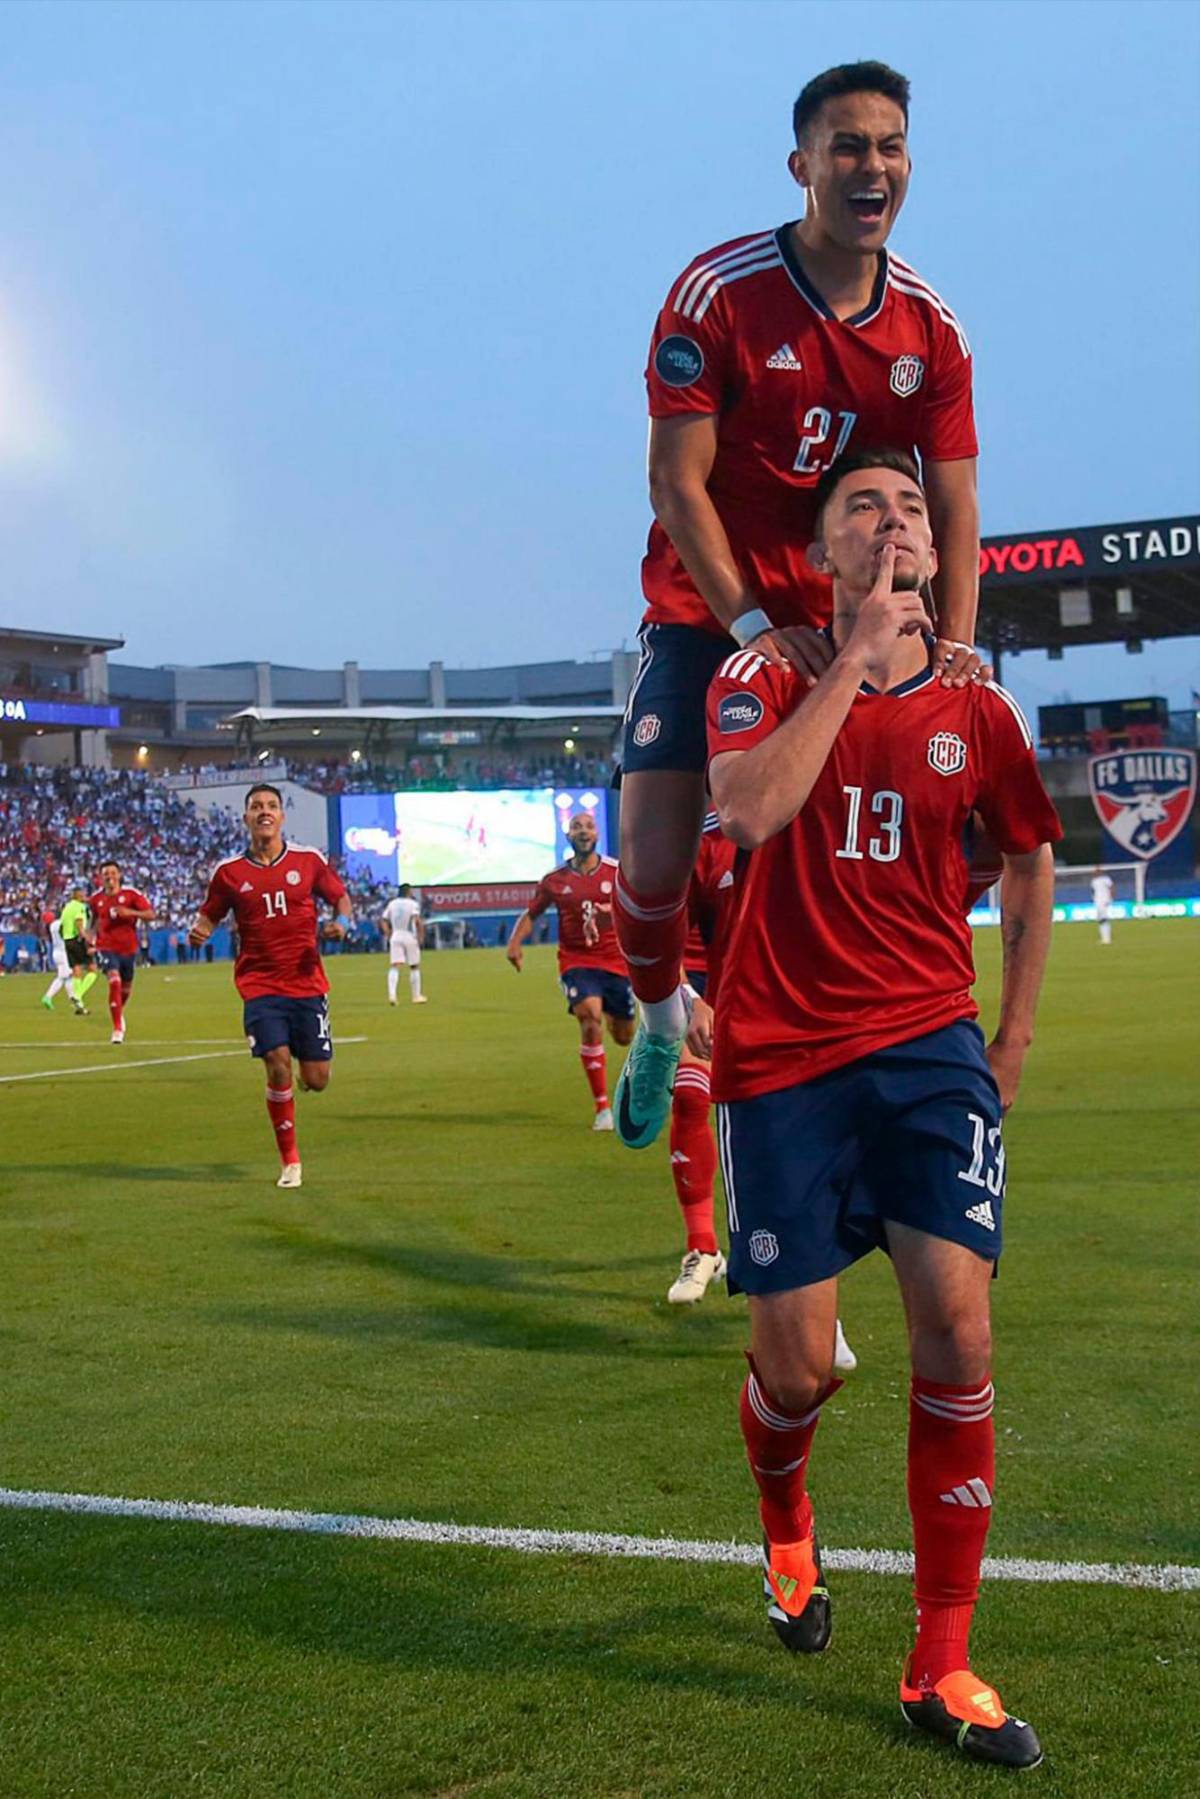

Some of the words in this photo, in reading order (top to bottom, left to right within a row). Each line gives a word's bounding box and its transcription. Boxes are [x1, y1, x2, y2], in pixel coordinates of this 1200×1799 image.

[765, 358, 802, 371] adidas
[793, 406, 858, 473] 21
[980, 538, 1085, 576] YOTA
[1102, 526, 1200, 564] STAD
[1096, 759, 1119, 788] FC
[1123, 755, 1188, 783] DALLAS
[835, 784, 904, 862] 13
[261, 890, 289, 919] 14
[957, 1112, 1007, 1198] 13
